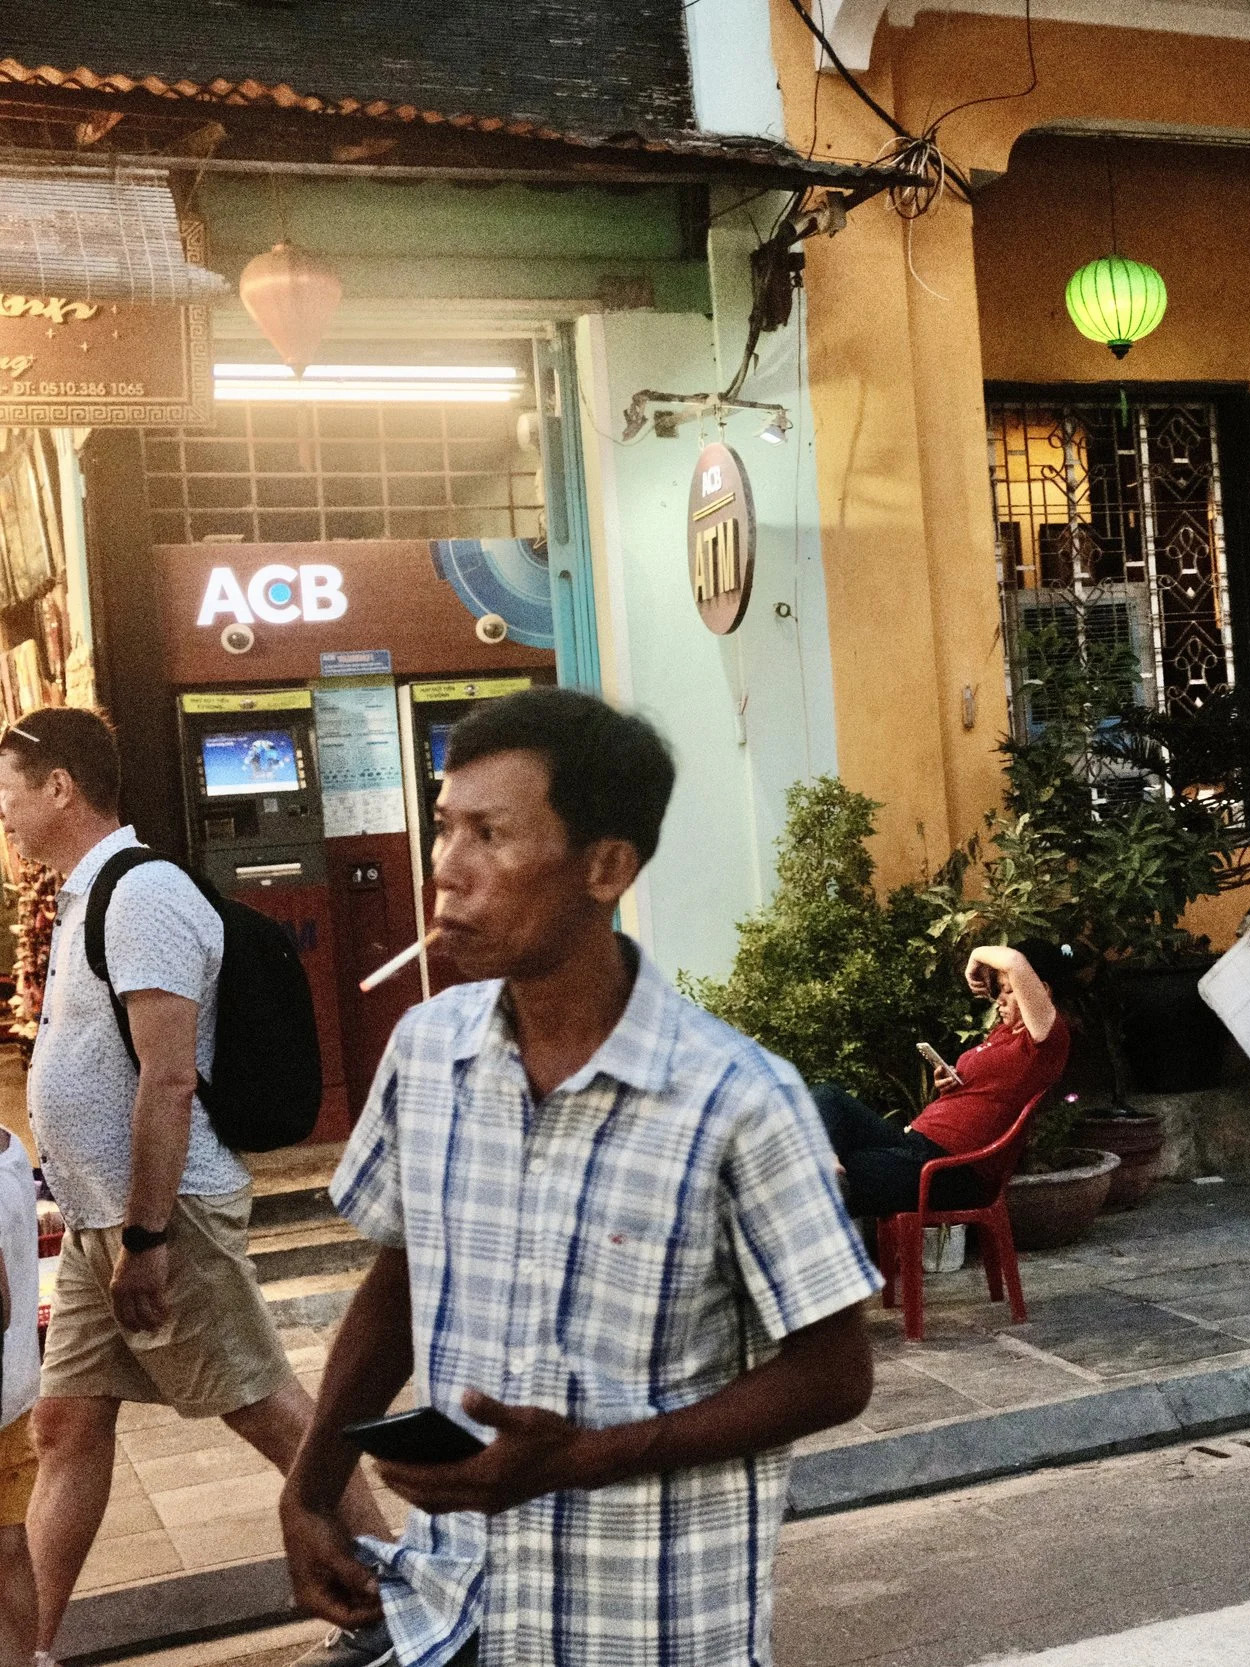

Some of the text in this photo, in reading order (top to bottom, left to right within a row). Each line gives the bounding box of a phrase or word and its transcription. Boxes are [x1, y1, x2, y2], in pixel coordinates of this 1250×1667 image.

[702, 466, 723, 497] ACB
[695, 517, 739, 602] ATM
[197, 564, 348, 626] ACB
